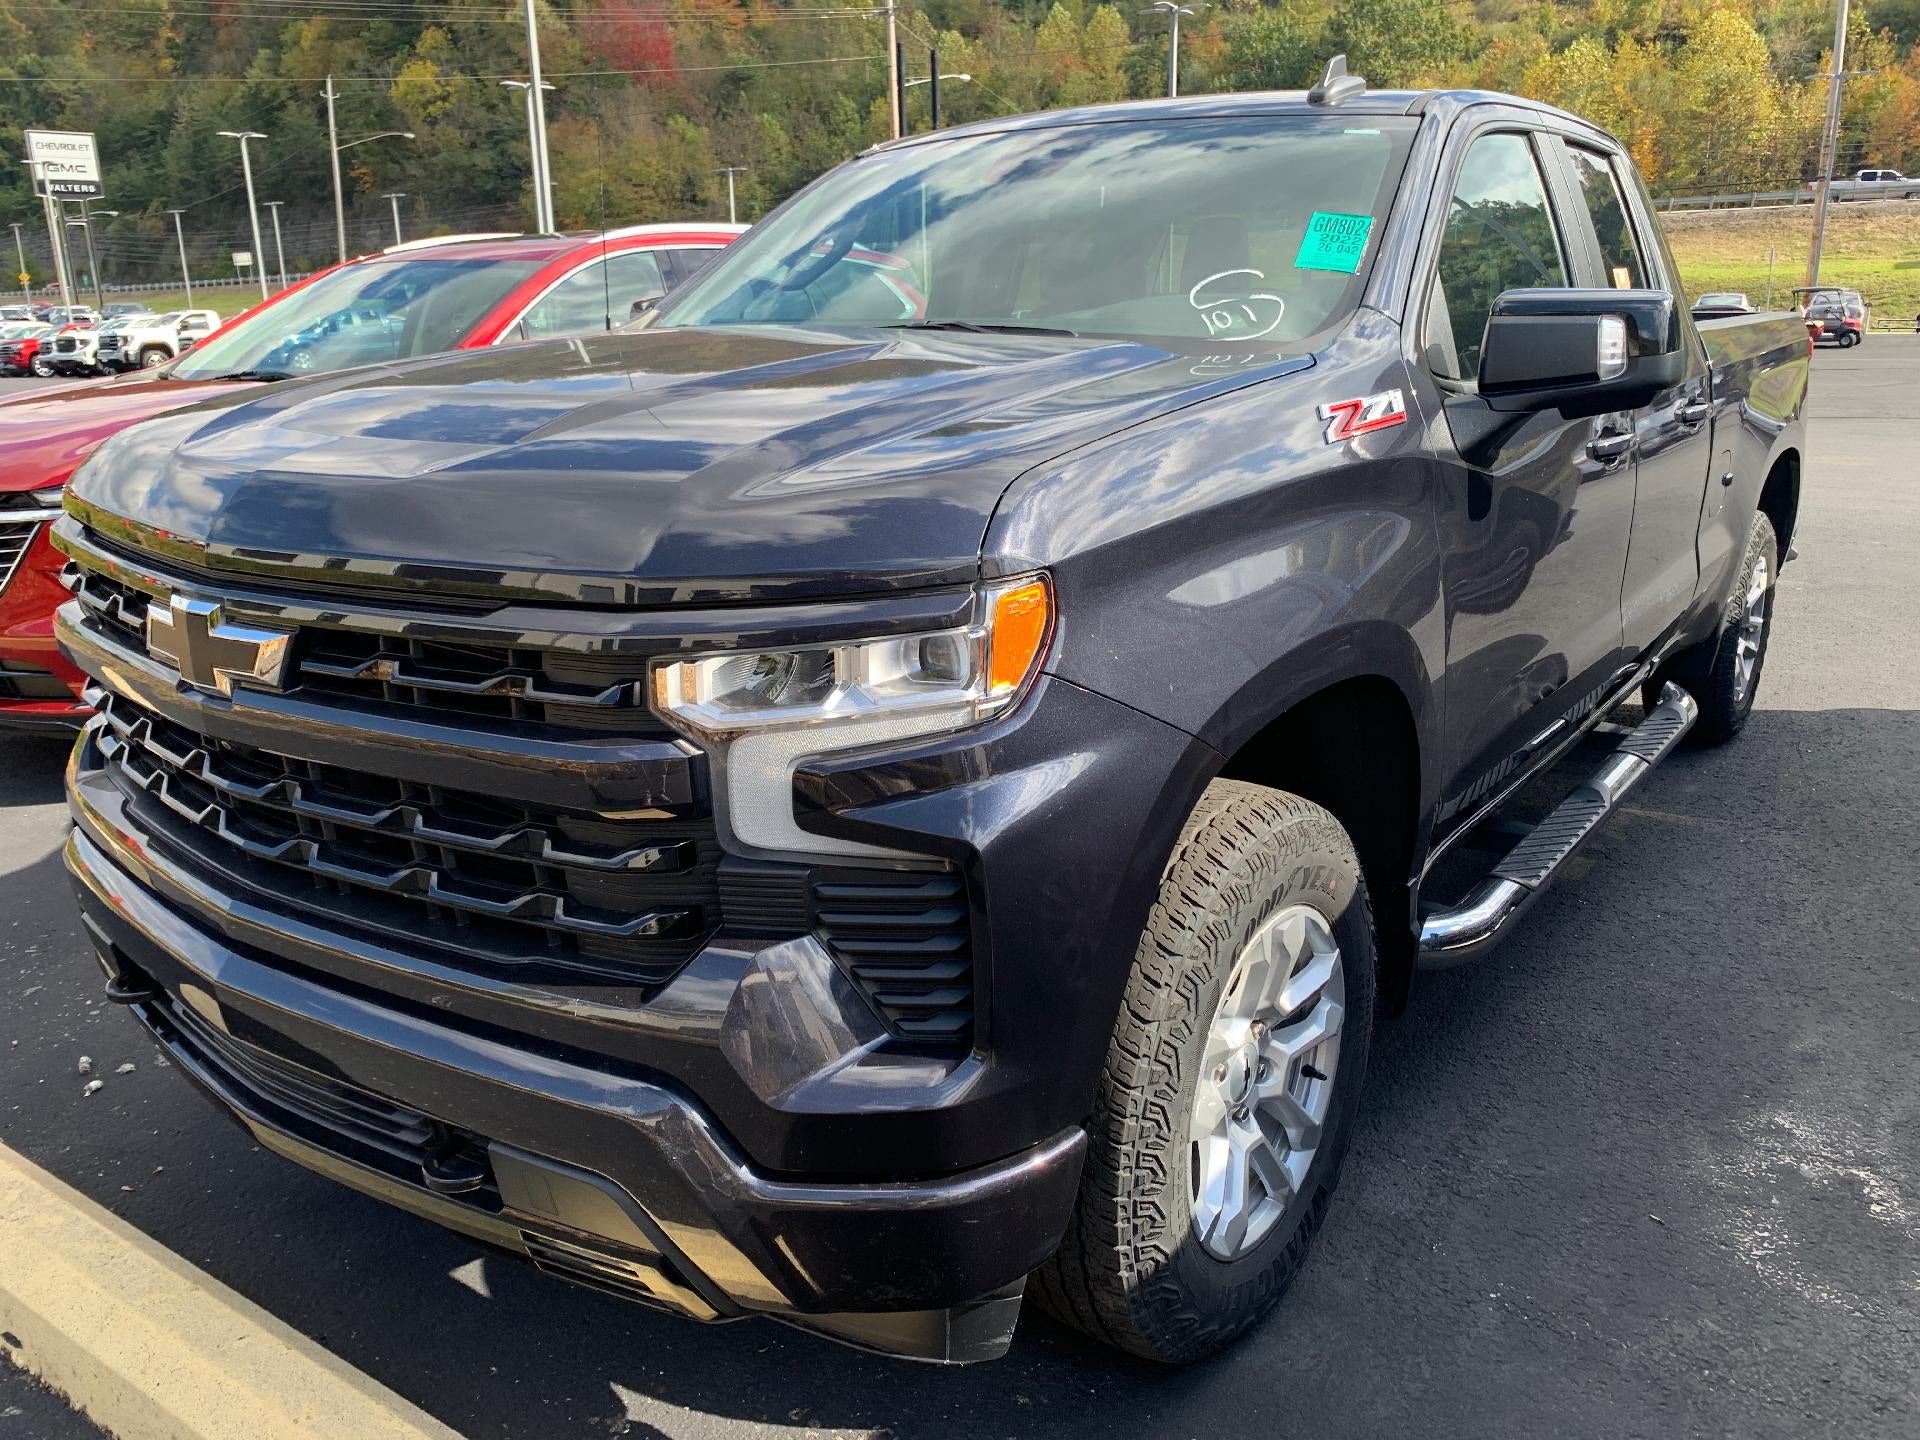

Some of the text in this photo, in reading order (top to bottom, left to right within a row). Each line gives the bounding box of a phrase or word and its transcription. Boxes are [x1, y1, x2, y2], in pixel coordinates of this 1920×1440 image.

[35, 141, 90, 152] CHEVROLET
[46, 163, 87, 173] GMC
[1319, 233, 1362, 246] 2022
